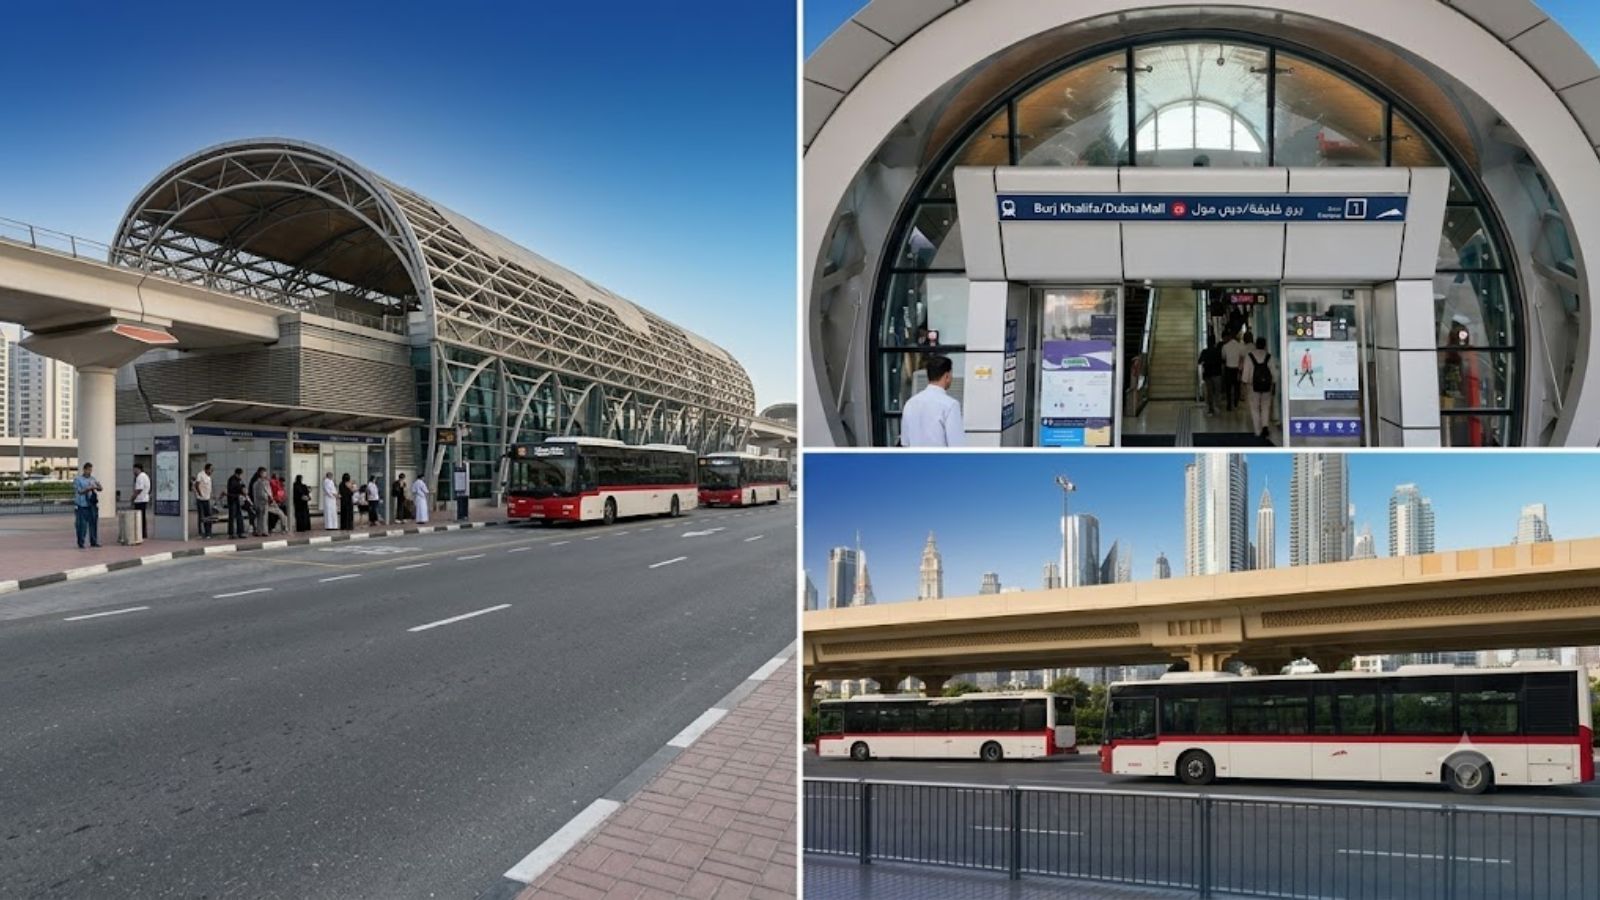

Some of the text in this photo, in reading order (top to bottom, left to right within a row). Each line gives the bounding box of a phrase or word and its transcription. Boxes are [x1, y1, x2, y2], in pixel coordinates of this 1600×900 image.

[1034, 202, 1057, 216] Burj
[1060, 202, 1139, 214] Khalifa/Dubai
[1141, 202, 1166, 214] Mall
[1353, 202, 1360, 215] 1
